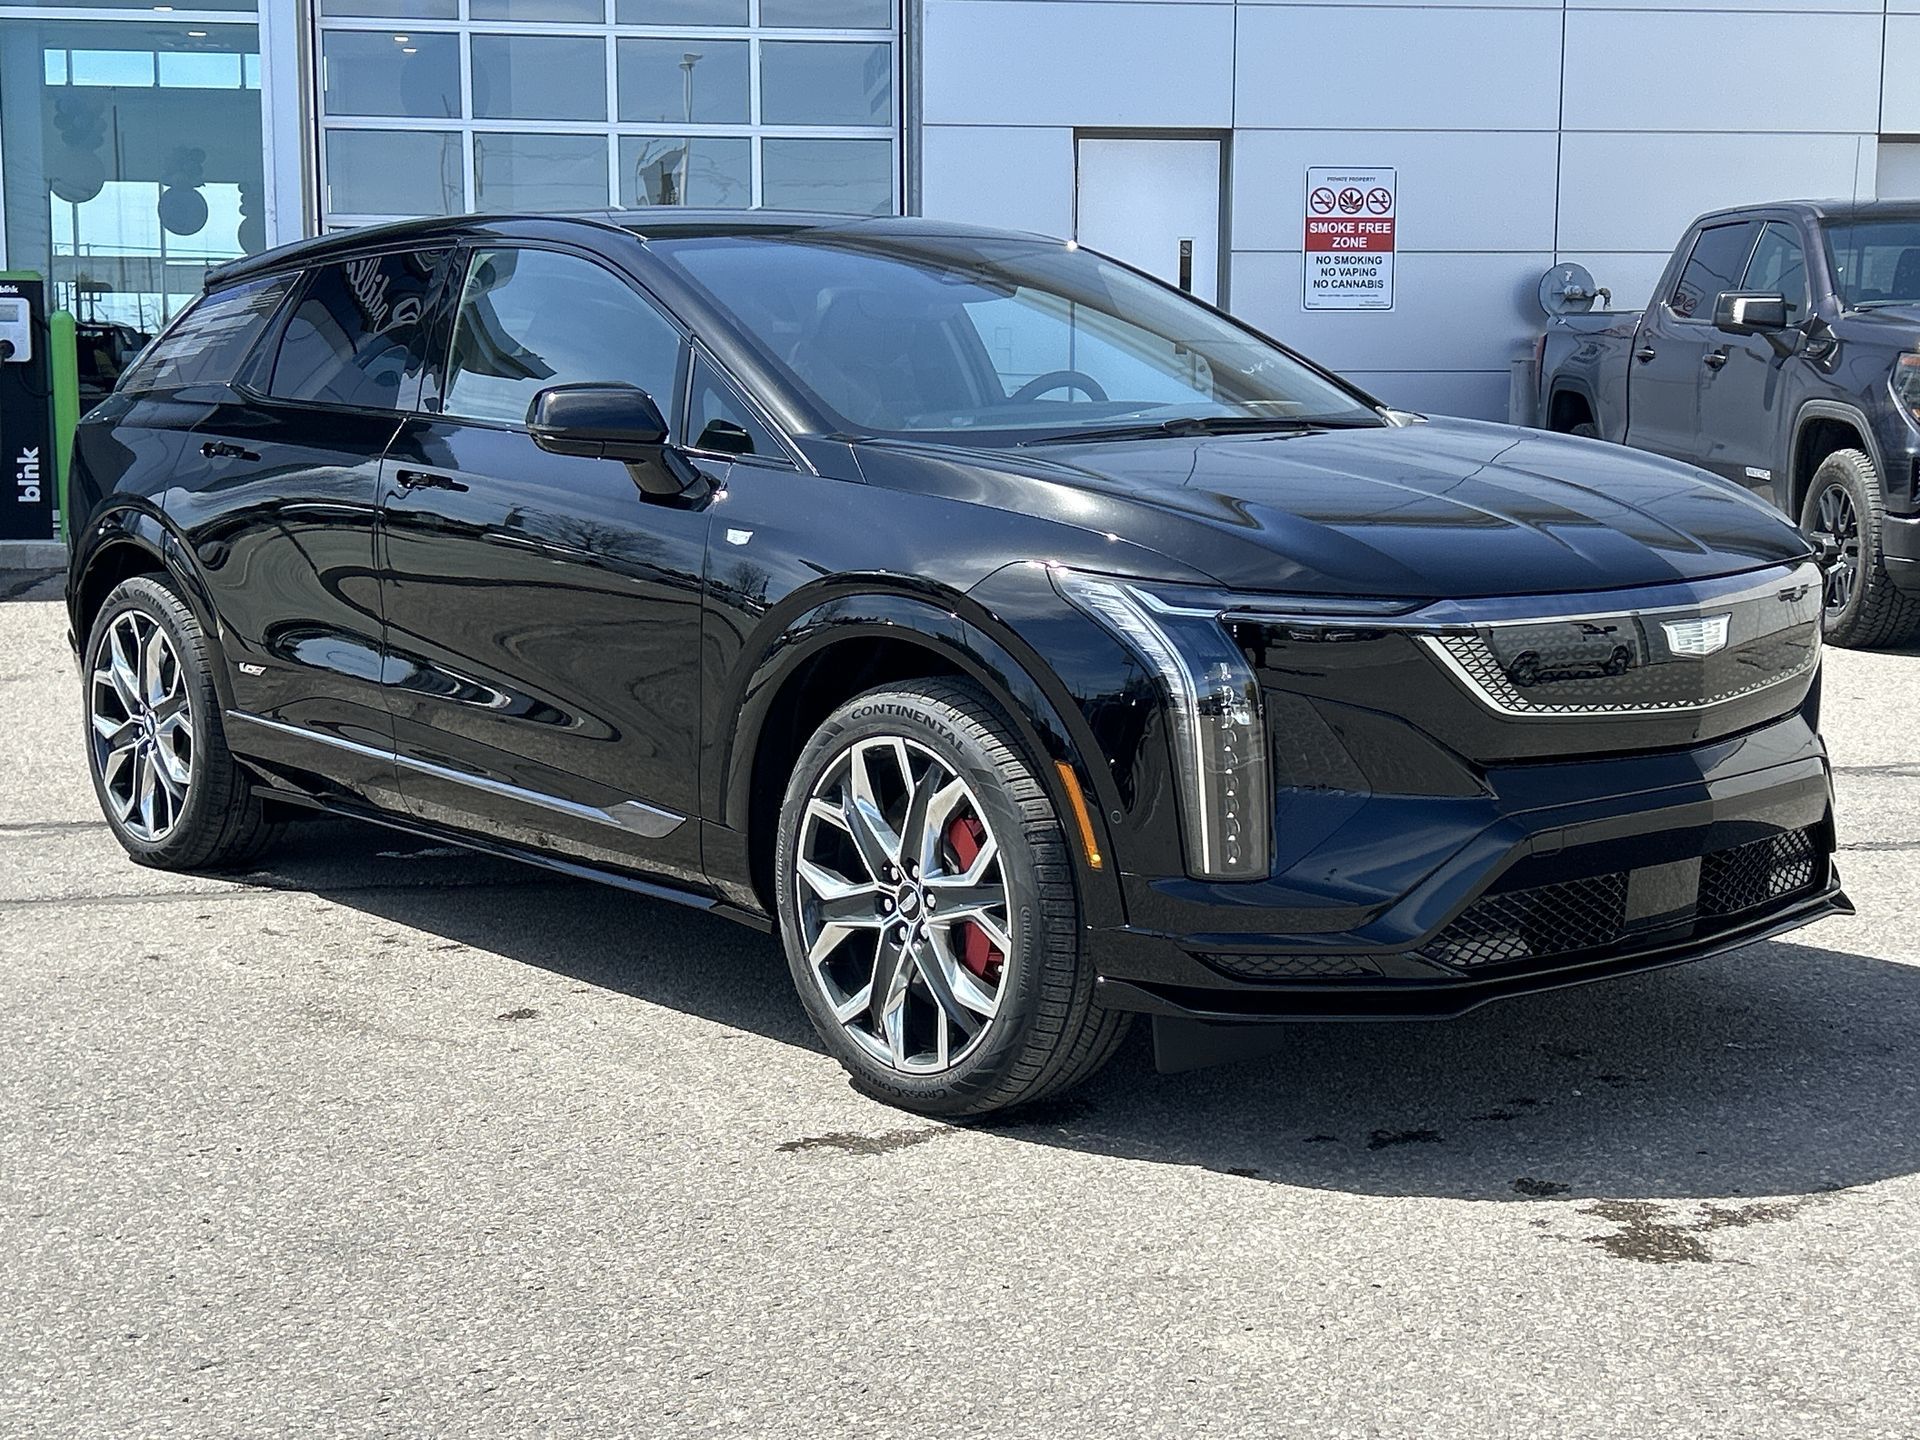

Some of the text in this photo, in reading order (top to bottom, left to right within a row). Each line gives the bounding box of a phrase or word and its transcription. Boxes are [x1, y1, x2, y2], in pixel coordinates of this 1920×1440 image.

[1309, 222, 1391, 234] SMOKE FREE
[1332, 236, 1368, 248] ZONE
[1315, 255, 1383, 265] NO SMOKING
[1320, 267, 1377, 277] NO VAPING
[1313, 279, 1384, 289] NO CANNABIS
[16, 446, 41, 503] blink
[851, 703, 964, 756] CONTINENTAL
